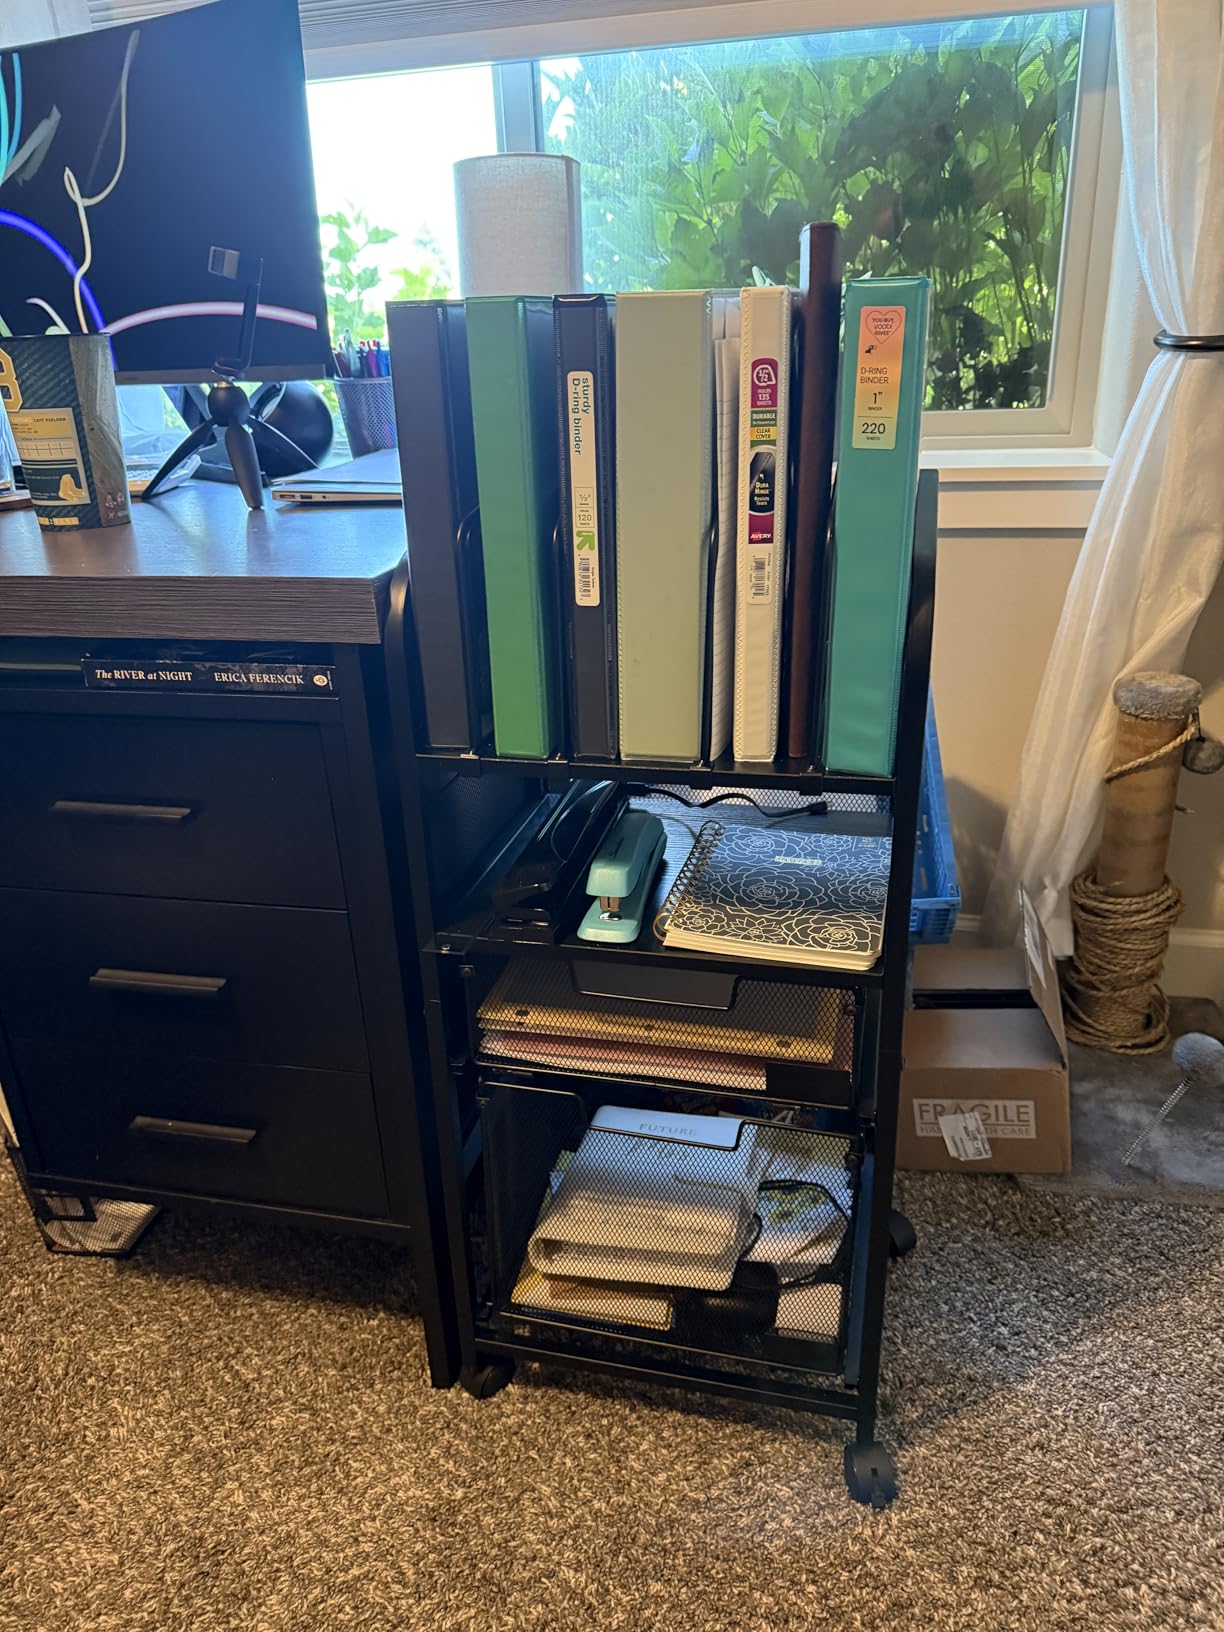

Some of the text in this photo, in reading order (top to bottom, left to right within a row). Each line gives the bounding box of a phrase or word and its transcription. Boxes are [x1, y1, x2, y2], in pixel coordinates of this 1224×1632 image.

[860, 367, 888, 375] D-RING
[860, 376, 889, 385] BINDER
[581, 377, 591, 415] sturdy
[758, 393, 771, 401] 135
[572, 378, 583, 456] D-ring binder
[861, 422, 886, 435] 220
[578, 514, 592, 522] 120
[95, 669, 305, 684] The RIVER at NIGHT ERICA FERENCIK
[918, 1103, 1031, 1123] FRAGILE
[639, 1122, 698, 1136] FUTURE
[1000, 1127, 1030, 1137] CARE
